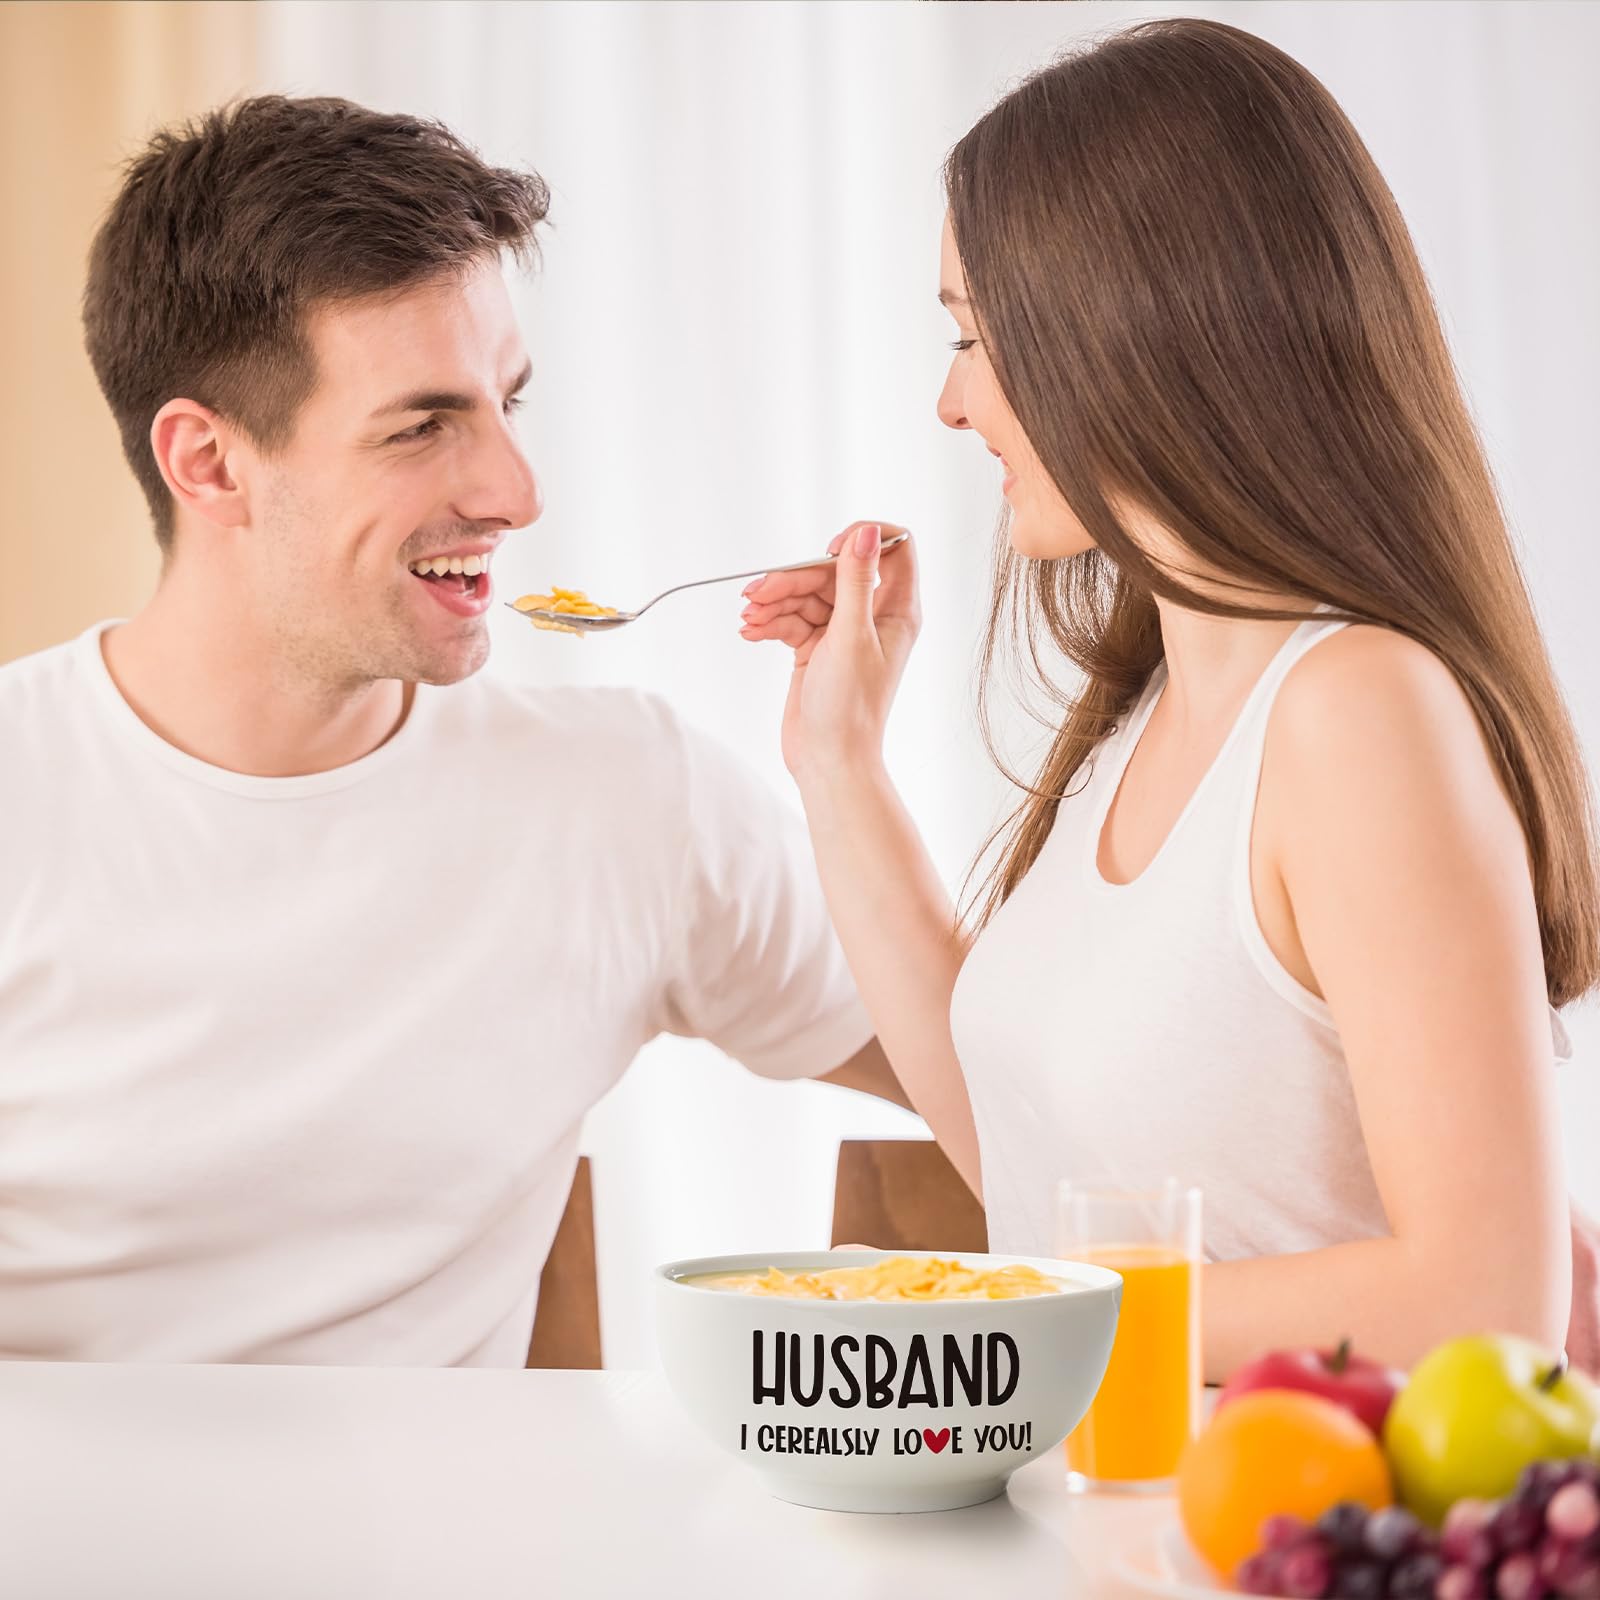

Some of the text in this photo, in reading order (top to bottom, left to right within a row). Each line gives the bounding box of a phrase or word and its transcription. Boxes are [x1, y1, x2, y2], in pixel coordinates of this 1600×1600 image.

[752, 1329, 1020, 1410] HUSBAND
[740, 1423, 748, 1451] I
[757, 1424, 880, 1457] CEREALSLY
[973, 1420, 1032, 1453] YOU!
